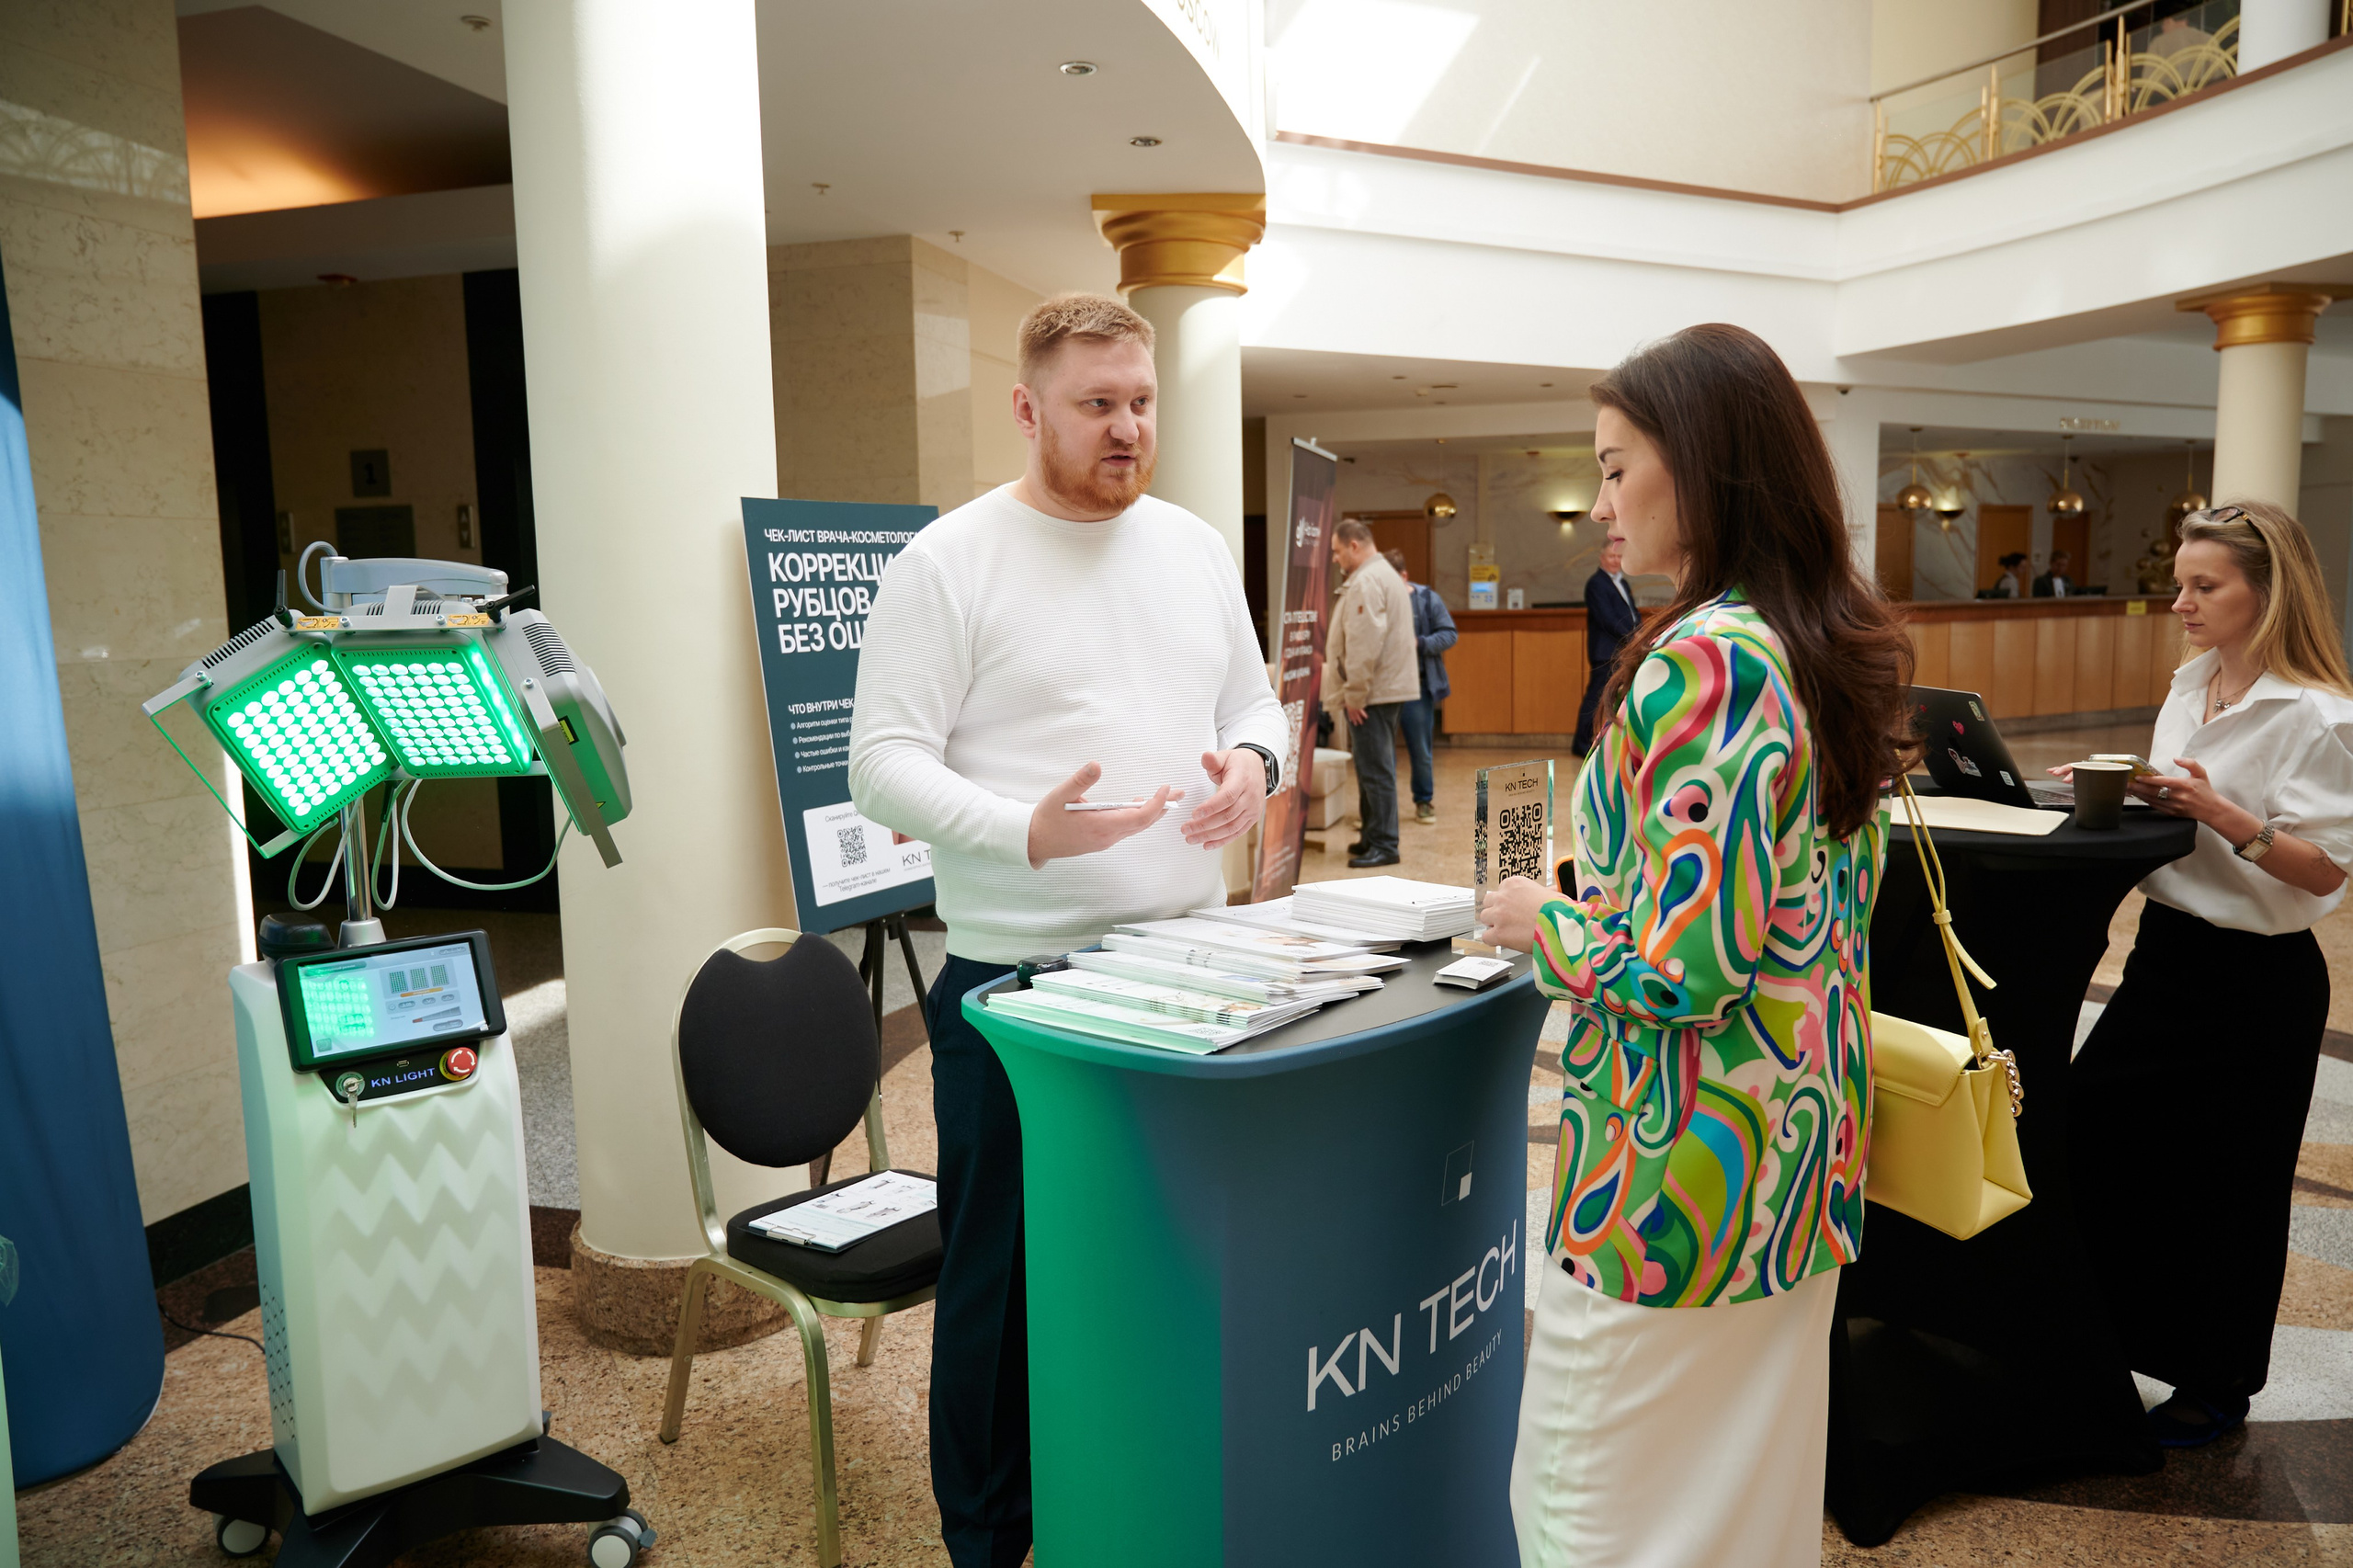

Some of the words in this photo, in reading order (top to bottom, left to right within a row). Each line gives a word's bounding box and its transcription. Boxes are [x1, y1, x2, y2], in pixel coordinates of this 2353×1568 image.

[364, 462, 378, 485] 1
[764, 528, 815, 542] ЧЕК-ЛИСТ
[816, 530, 918, 544] ВРАЧА-КОСМЕТОЛОГ
[773, 586, 872, 622] РУБЦОВ
[778, 622, 826, 654] БЕЗ
[789, 704, 806, 714] ЧТО
[806, 699, 838, 713] ВНУТРИ
[1505, 781, 1517, 792] KN
[1518, 778, 1539, 790] TECH
[902, 851, 922, 867] KN
[370, 1076, 392, 1088] KN
[395, 1068, 435, 1084] LIGHT
[1307, 1312, 1402, 1412] KN
[1419, 1218, 1518, 1355] TECH
[1332, 1414, 1401, 1461] BRAINS
[1407, 1372, 1462, 1424] BEHIND
[1465, 1328, 1503, 1381] BEAUTY
